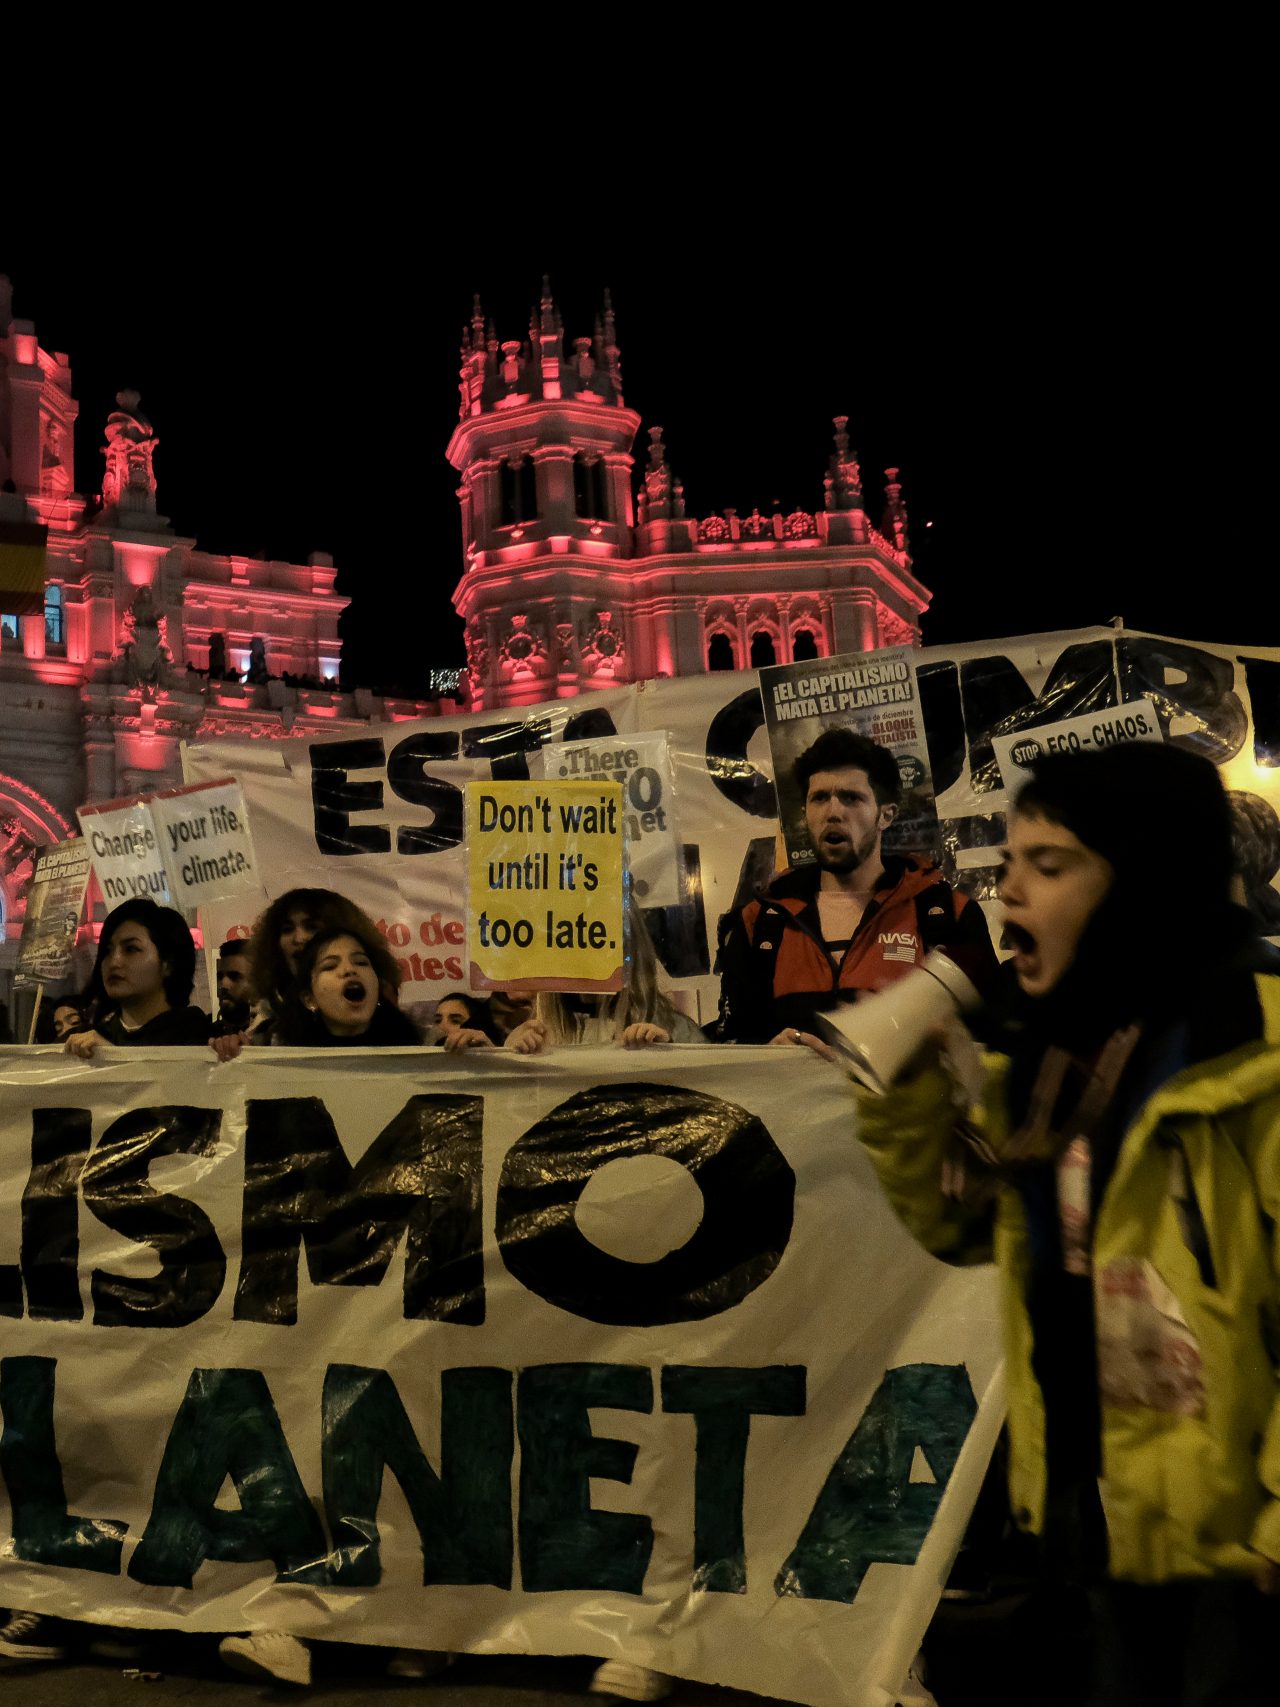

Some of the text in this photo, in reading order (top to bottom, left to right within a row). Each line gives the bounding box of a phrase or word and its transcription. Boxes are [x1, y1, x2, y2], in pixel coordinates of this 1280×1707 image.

[773, 662, 908, 702] ¡EL CAPITALISMO
[776, 682, 911, 721] MATA EL PLANETA!
[872, 713, 880, 721] de
[882, 709, 914, 720] diciembre
[872, 718, 915, 735] BLOQUE
[1014, 746, 1039, 763] STOP
[91, 804, 243, 860] Change your life,
[478, 795, 617, 834] Don't wait
[104, 876, 128, 899] no
[128, 869, 167, 897] your
[182, 849, 251, 886] climate.
[488, 853, 599, 891] until it's
[420, 912, 466, 947] de
[478, 910, 617, 949] too late.
[878, 932, 919, 948] NASA
